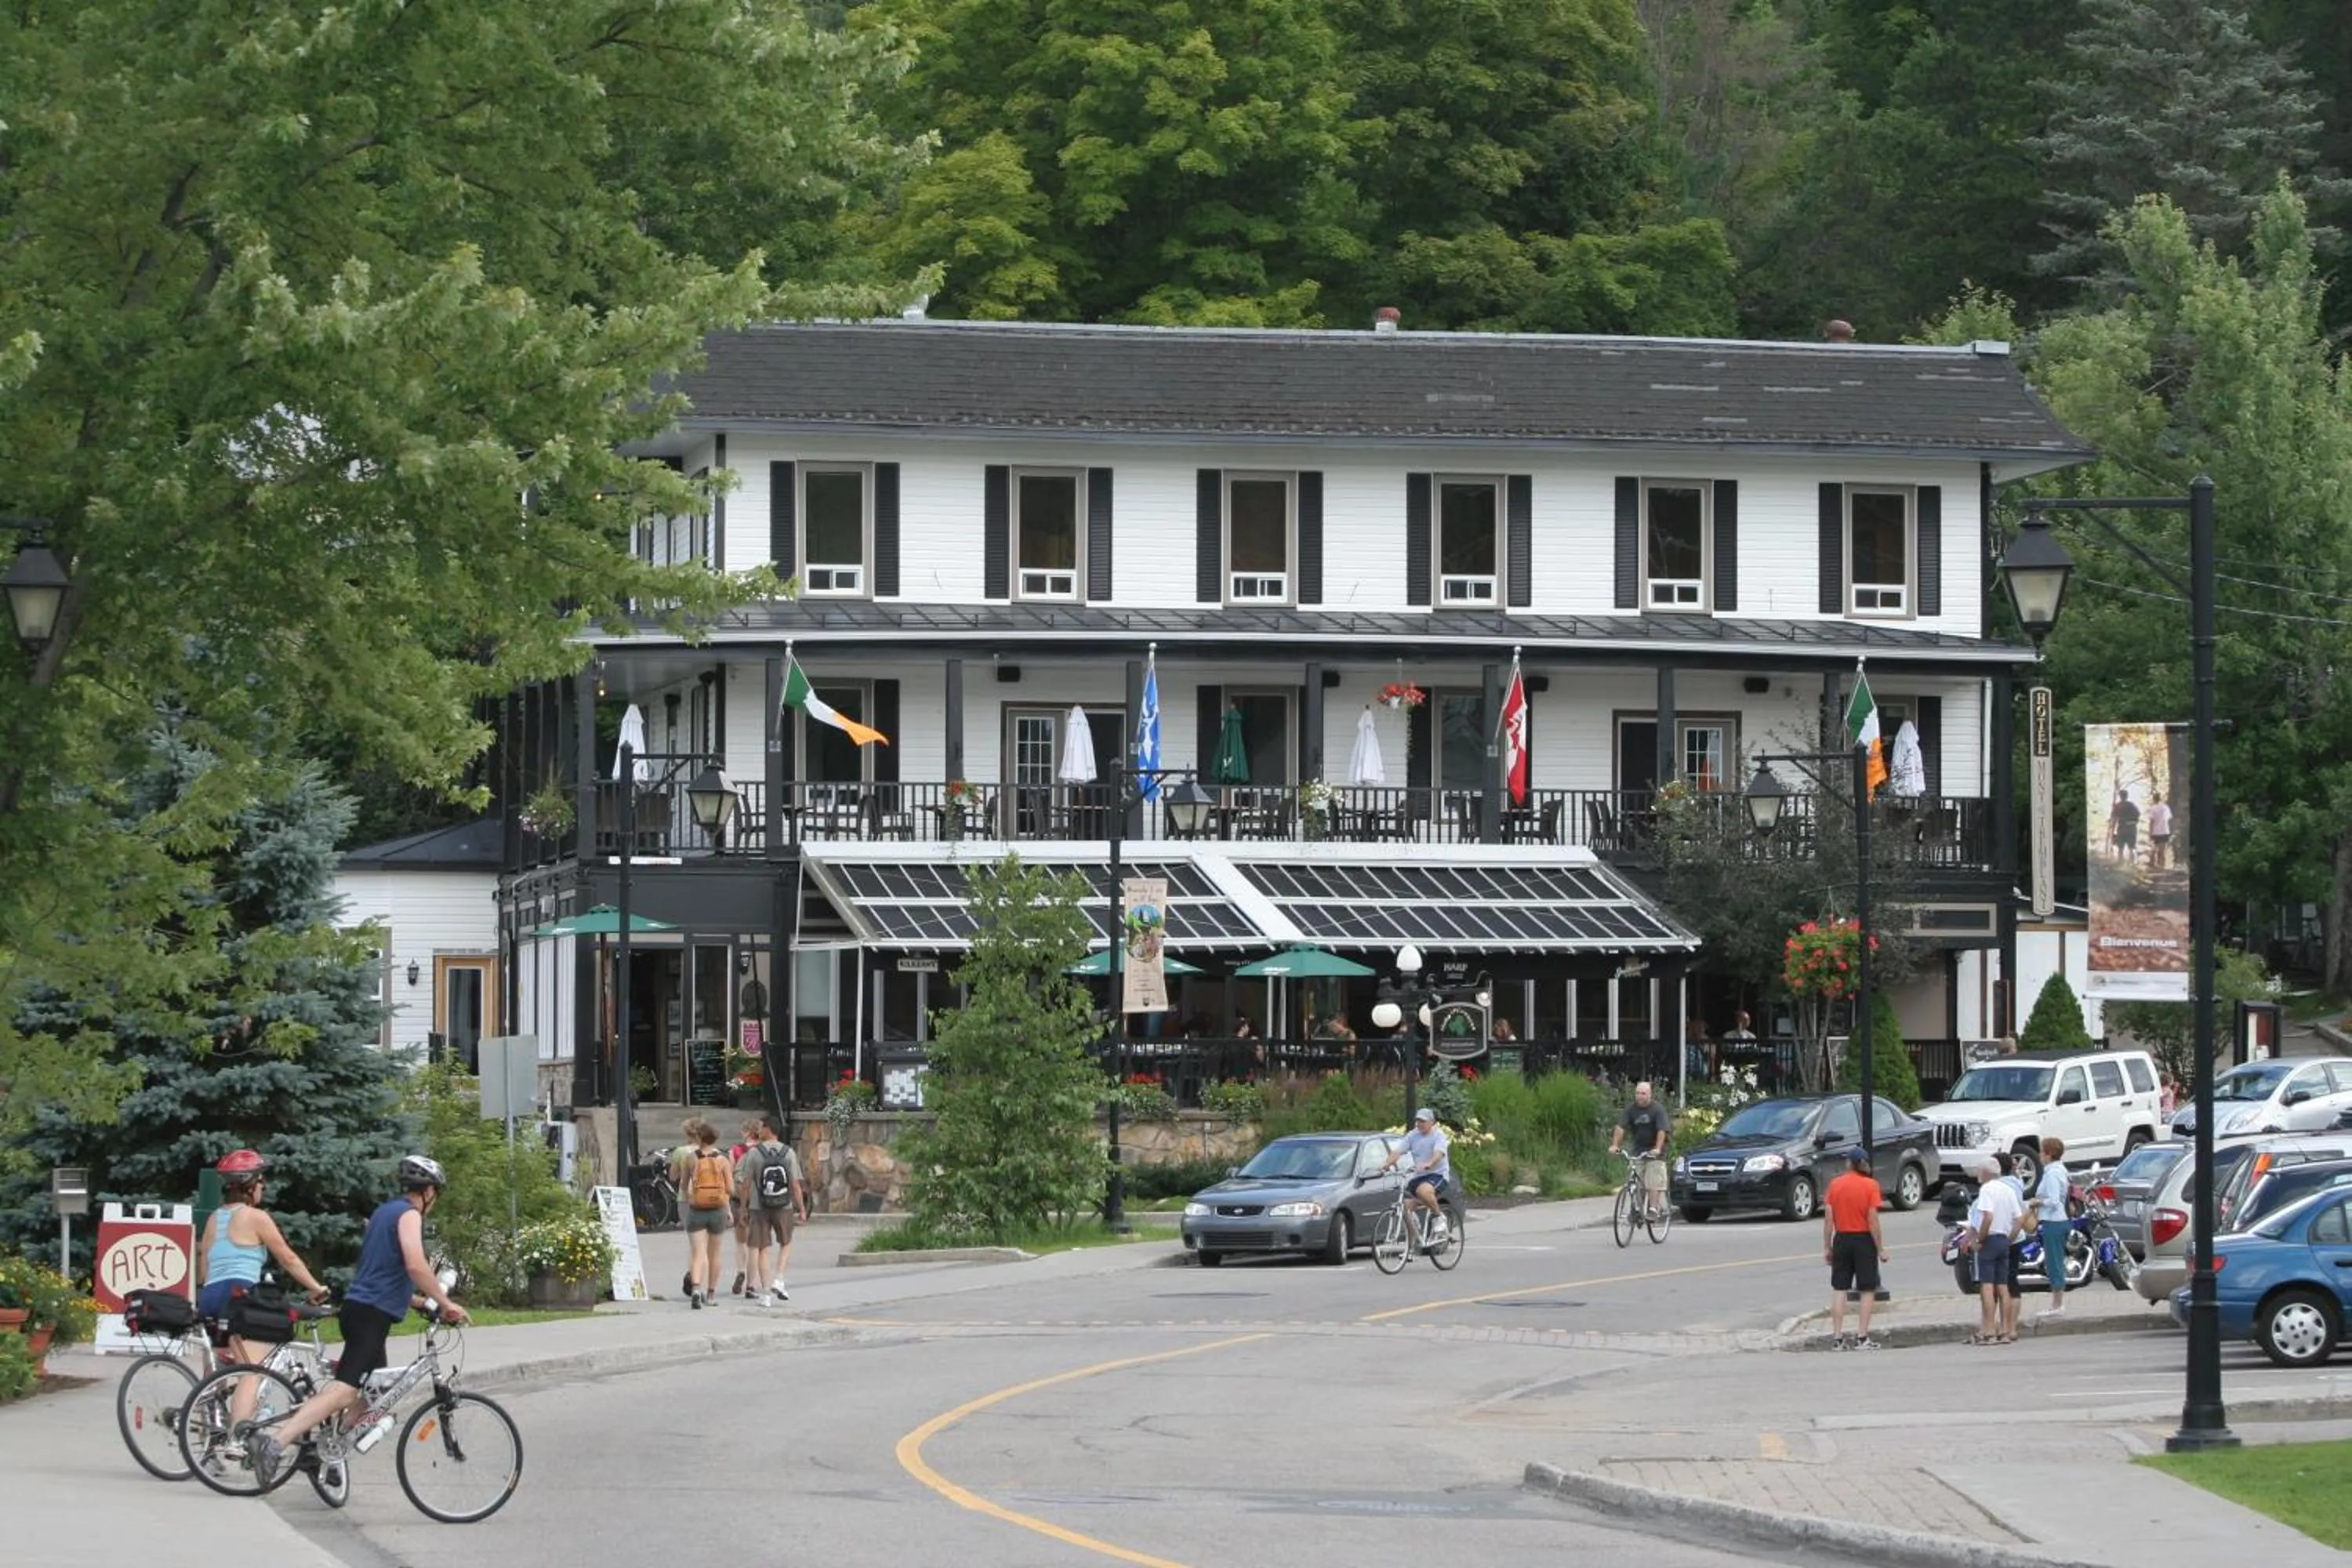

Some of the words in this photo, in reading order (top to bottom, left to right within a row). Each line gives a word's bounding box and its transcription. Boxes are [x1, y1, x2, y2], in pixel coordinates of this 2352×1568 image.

[2036, 692, 2045, 754] HOTEL
[2100, 936, 2177, 948] Bienvenue
[112, 1243, 176, 1287] ART
